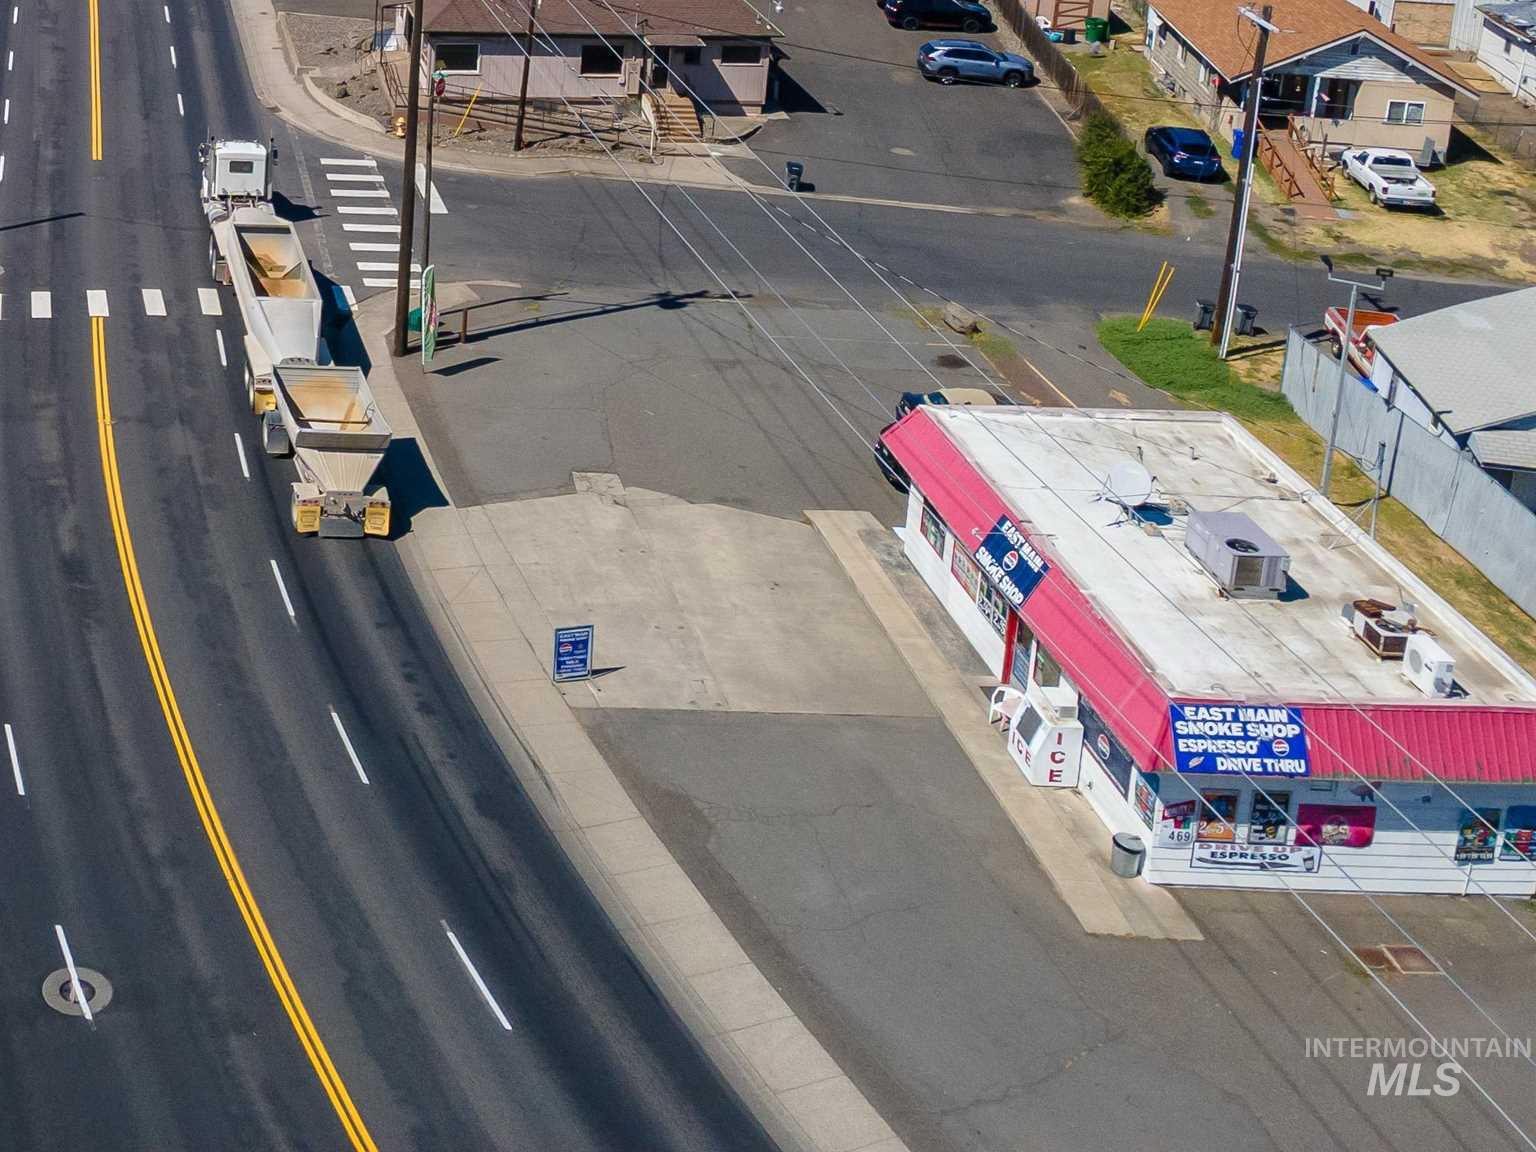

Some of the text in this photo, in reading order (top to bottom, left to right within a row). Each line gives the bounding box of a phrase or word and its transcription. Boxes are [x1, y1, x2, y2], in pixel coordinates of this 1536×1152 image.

[1002, 520, 1026, 549] EAST
[1018, 542, 1045, 573] MAIN
[975, 546, 1006, 585] SMOKE
[999, 575, 1025, 605] SHOP
[1184, 706, 1288, 723] EAST MAIN
[1175, 720, 1301, 738] SMOKE SHOP
[1011, 731, 1032, 769] ICE
[1178, 738, 1259, 755] ESPRESSO
[1048, 732, 1066, 783] ICE
[1216, 757, 1262, 772] DRIVE
[1263, 758, 1306, 774] THRU
[1199, 843, 1302, 854] DRIVE UP
[1210, 851, 1290, 861] ESPRESSO
